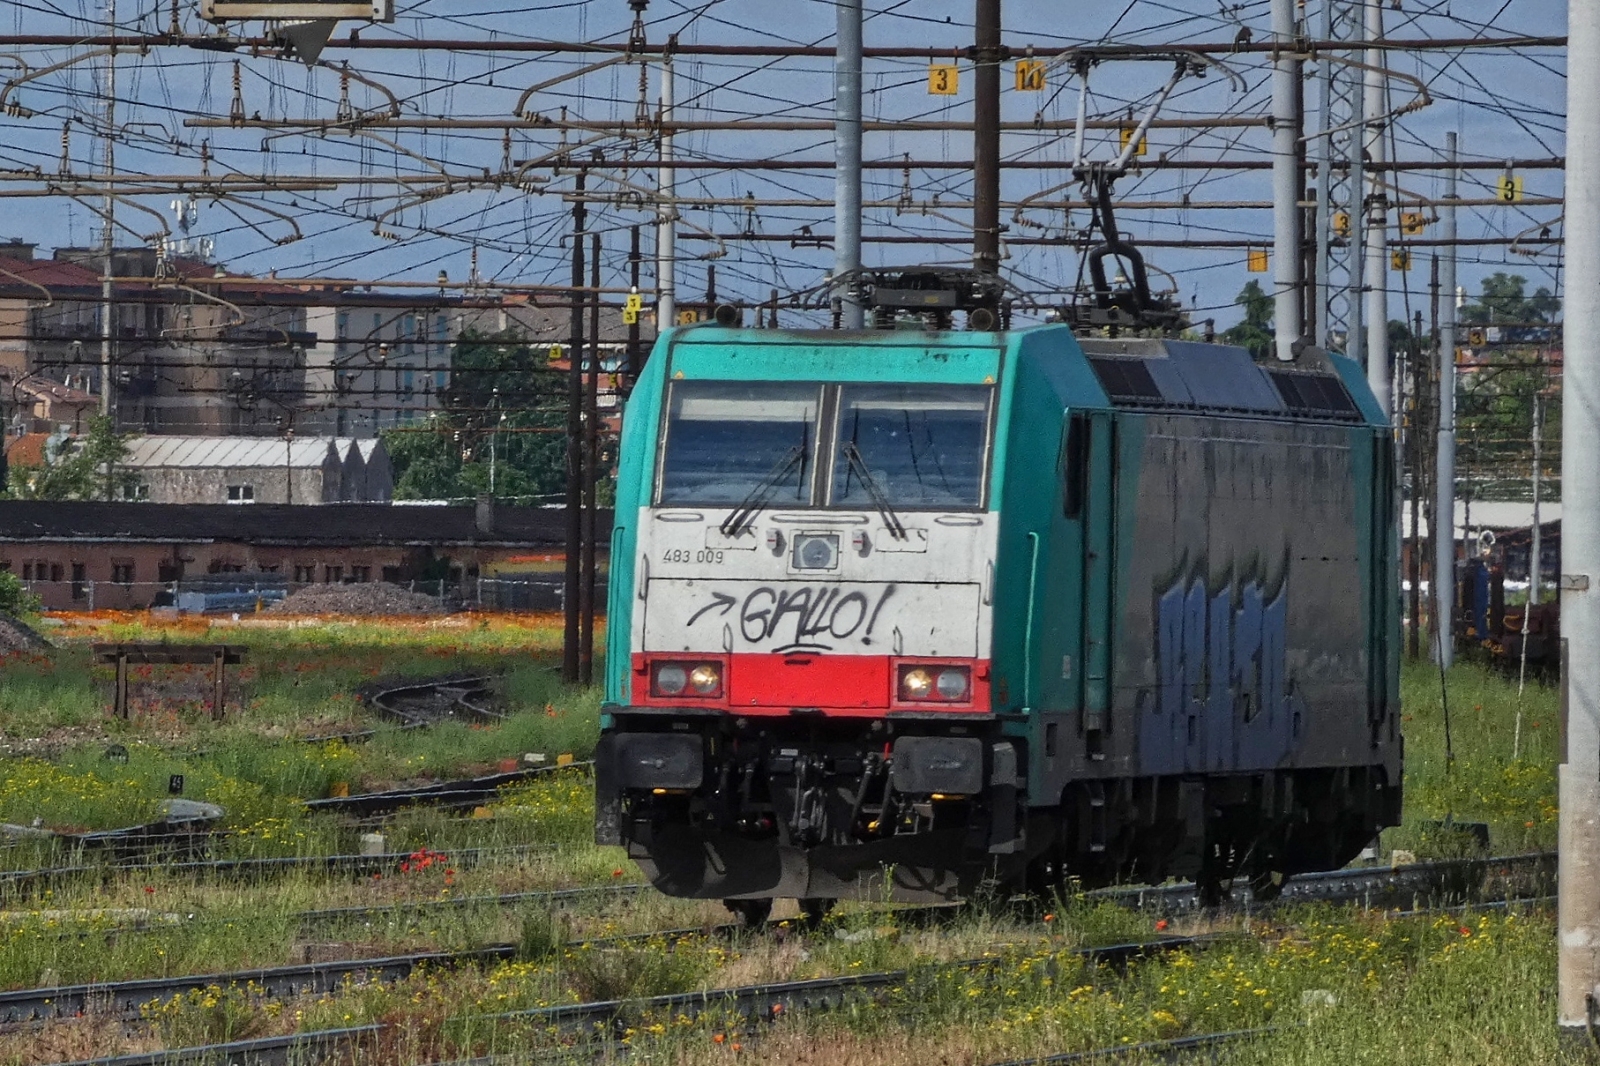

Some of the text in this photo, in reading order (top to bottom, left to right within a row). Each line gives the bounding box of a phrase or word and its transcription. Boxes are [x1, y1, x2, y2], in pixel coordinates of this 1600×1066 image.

[937, 68, 948, 91] 3
[1503, 180, 1515, 200] 3
[1471, 332, 1482, 345] 3
[663, 549, 724, 564] 483 009
